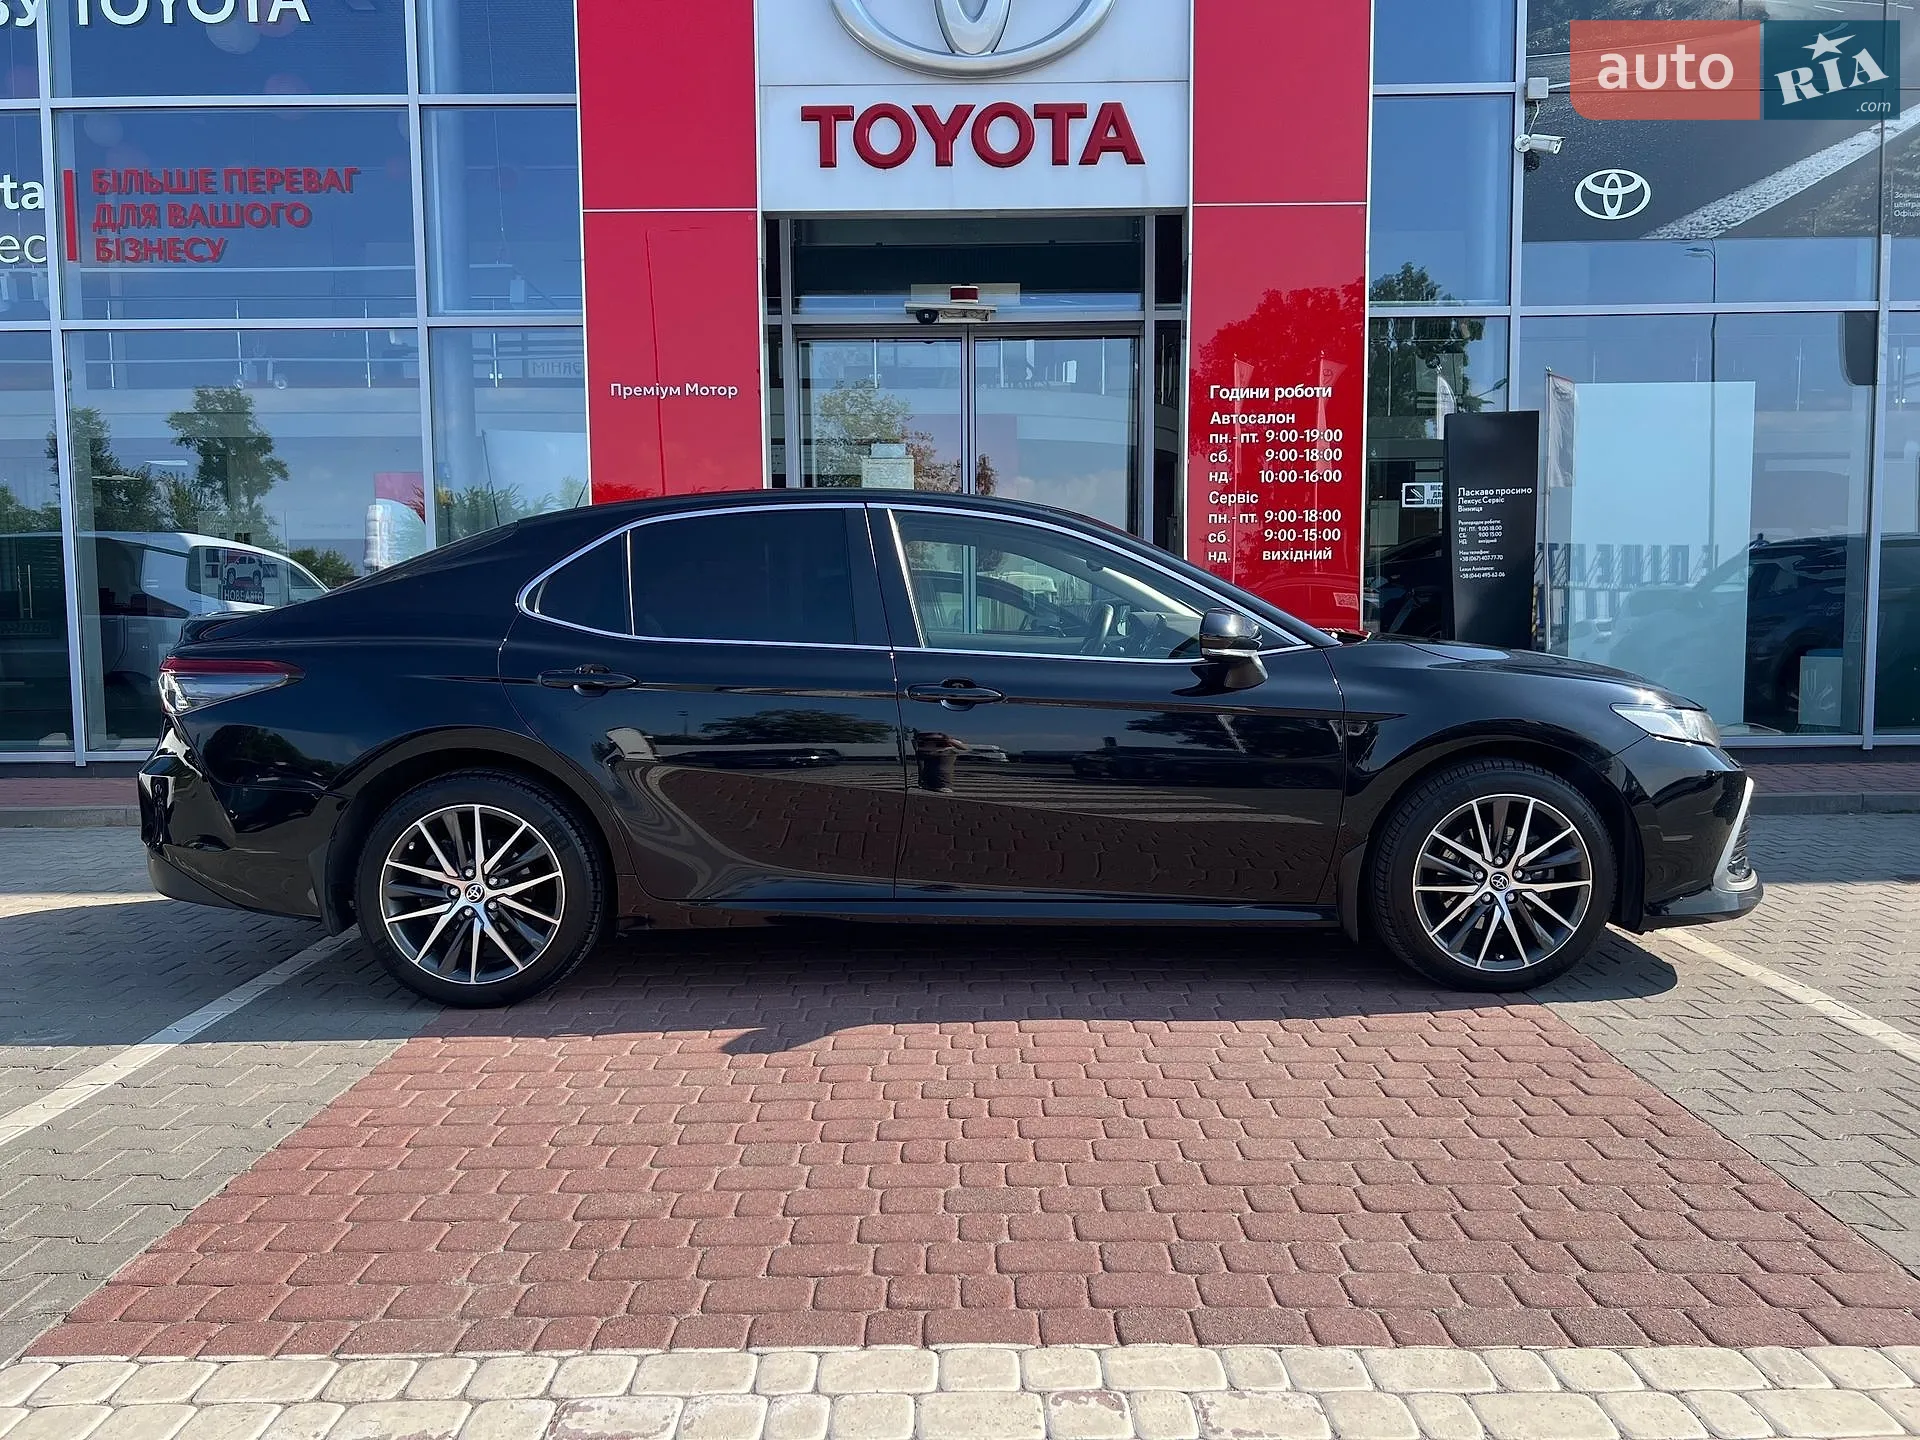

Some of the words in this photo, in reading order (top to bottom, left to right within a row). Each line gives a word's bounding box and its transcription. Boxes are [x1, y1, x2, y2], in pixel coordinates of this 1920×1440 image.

[801, 102, 1145, 169] TOYOTA
[91, 168, 217, 195] БІЛЬШЕ
[223, 168, 361, 193] ПЕРЕВАГ
[92, 203, 161, 232] ДЛЯ
[167, 202, 313, 229] ВАШОГО
[95, 236, 229, 263] БІЗНЕСУ
[610, 383, 681, 398] Преміум
[685, 383, 738, 397] Мотор
[1210, 385, 1269, 401] Години
[1274, 384, 1332, 402] роботи
[1210, 411, 1295, 425] Автосалон
[1265, 429, 1343, 443] 9:00-19:00
[1209, 450, 1231, 463] сб.
[1265, 448, 1343, 462] 9:00-18:00
[1209, 471, 1232, 484] нд.
[1259, 469, 1342, 483] 10:00-16:00
[1209, 491, 1259, 506] Сервіс
[1264, 509, 1341, 523] 9:00-18:00
[1208, 530, 1230, 543] сб.
[1264, 528, 1341, 542] 9:00-15:00
[1208, 550, 1230, 562] нд.
[1263, 547, 1332, 562] вихідний
